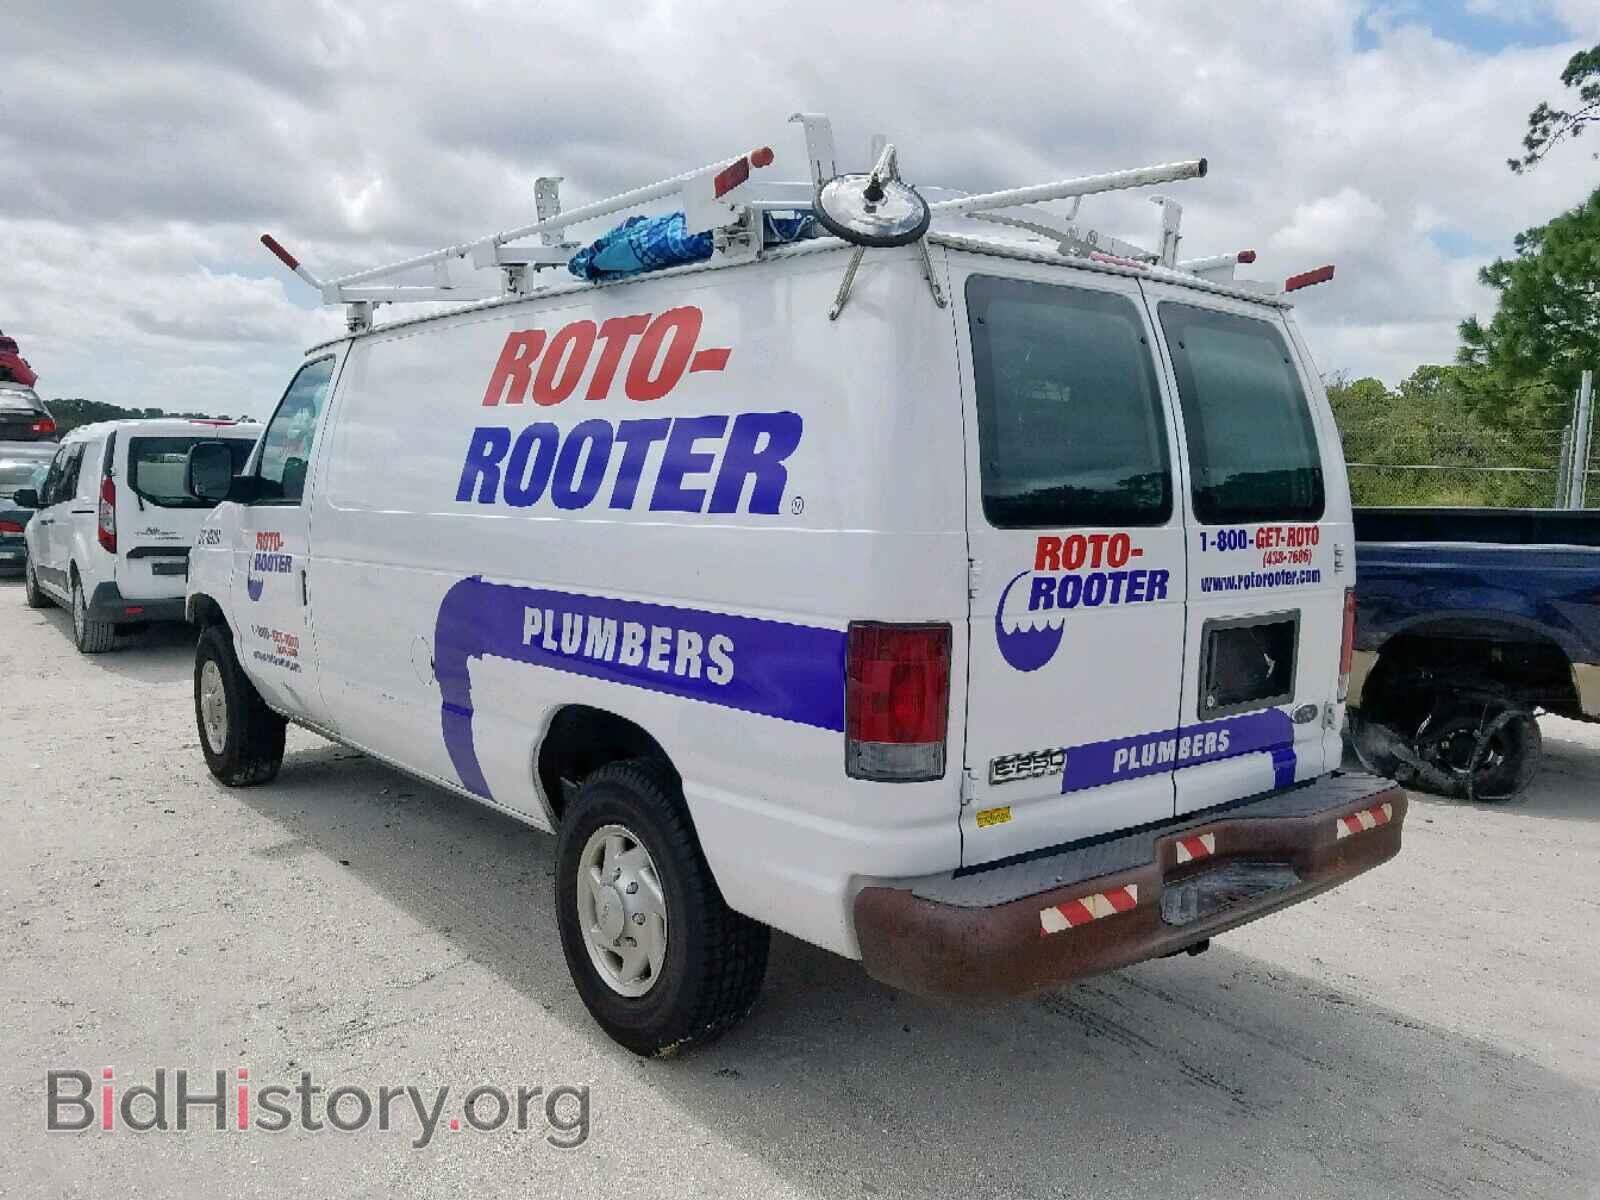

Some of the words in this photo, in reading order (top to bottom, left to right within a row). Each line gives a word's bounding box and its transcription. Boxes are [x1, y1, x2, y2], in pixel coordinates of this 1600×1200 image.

[482, 305, 732, 407] ROTO-
[455, 411, 803, 515] ROOTER
[1034, 533, 1143, 571] ROTO-
[1199, 525, 1320, 552] 1-800-GET-ROTO
[254, 553, 293, 574] ROOTER
[1200, 568, 1321, 592] www.rotorooter.com
[1028, 569, 1170, 611] ROOTER
[522, 606, 735, 686] PLUMBERS
[1112, 729, 1231, 773] PLUMBERS
